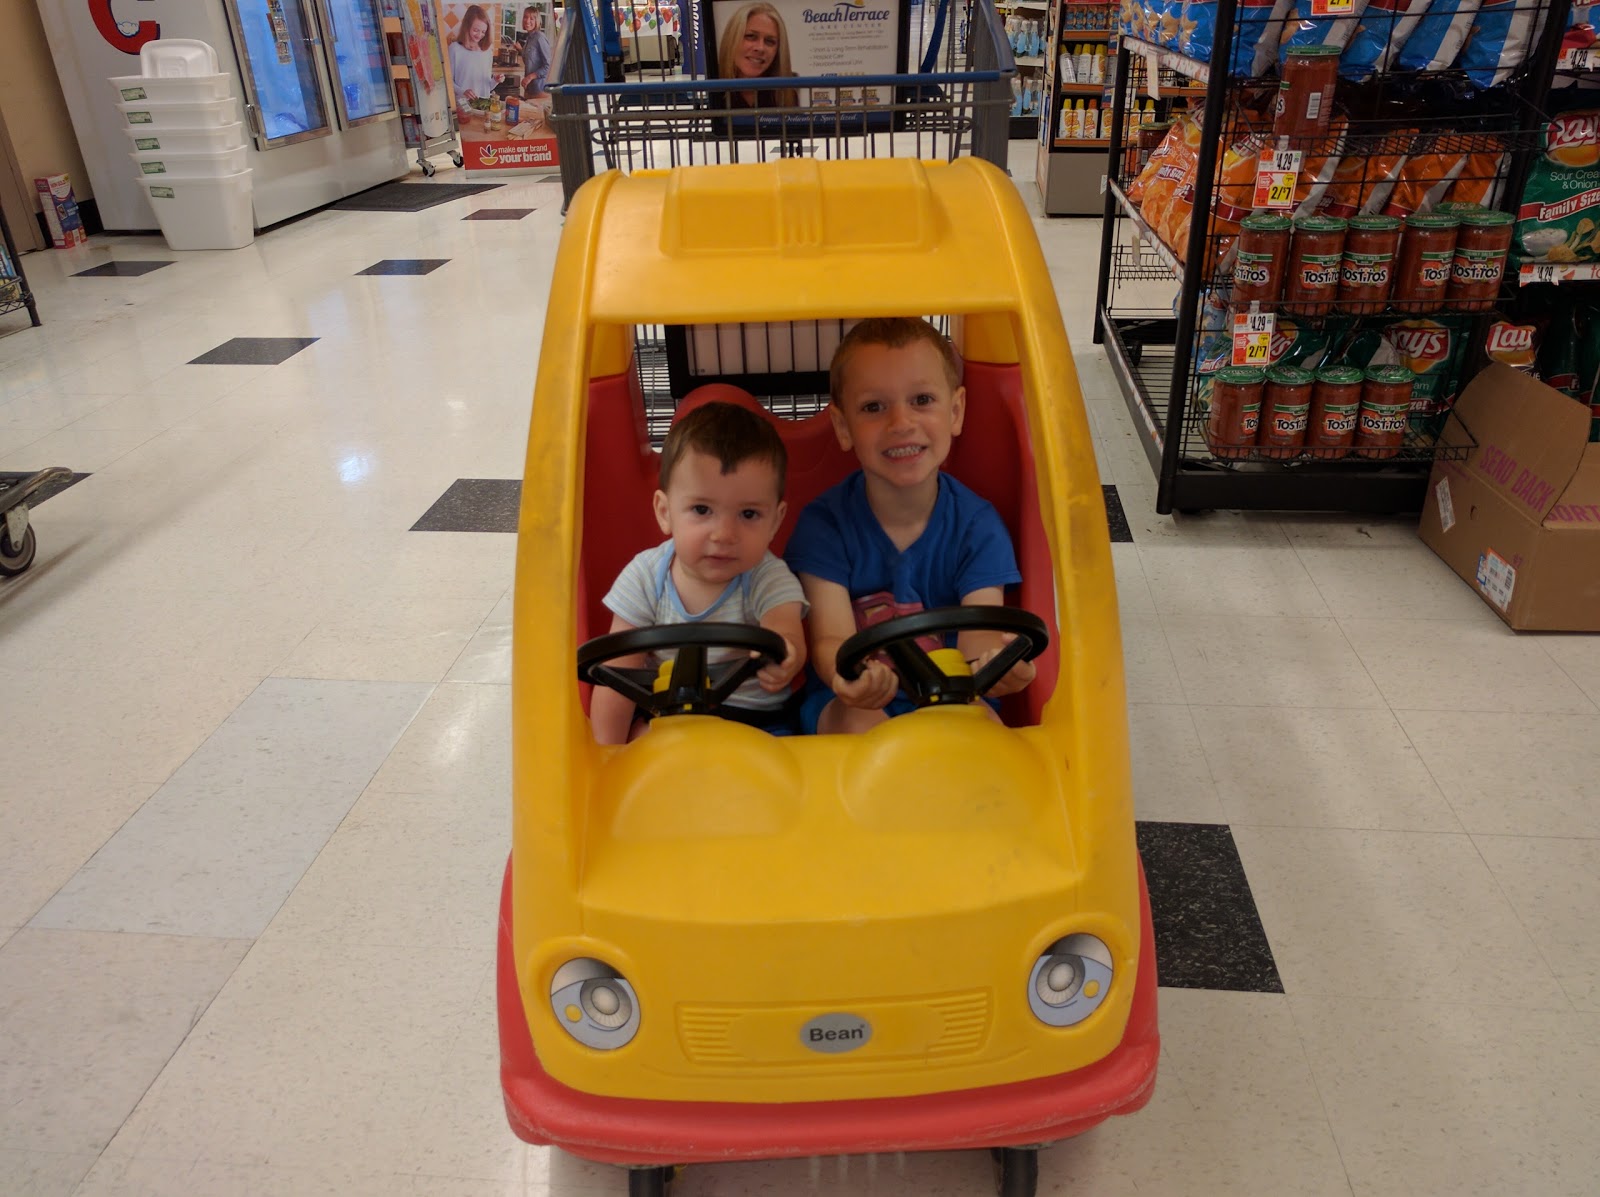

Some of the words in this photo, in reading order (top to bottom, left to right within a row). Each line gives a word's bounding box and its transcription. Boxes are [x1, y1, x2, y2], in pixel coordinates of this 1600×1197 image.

[530, 144, 548, 152] brand
[499, 153, 522, 164] your
[523, 151, 552, 162] brand
[1276, 153, 1293, 170] $4.29
[1550, 171, 1574, 182] Sour
[1575, 169, 1600, 179] Crea
[1271, 187, 1291, 200] 2/$7
[1539, 199, 1578, 220] Family
[1343, 267, 1387, 282] TOSTITOS
[1453, 263, 1499, 279] TOSTITOS
[1249, 316, 1267, 332] $4.29
[1248, 346, 1267, 358] 2/$7
[1363, 416, 1405, 430] TOSTITOS
[1480, 444, 1518, 486] SEND
[1511, 467, 1556, 513] BACK
[809, 1027, 864, 1042] Bean
